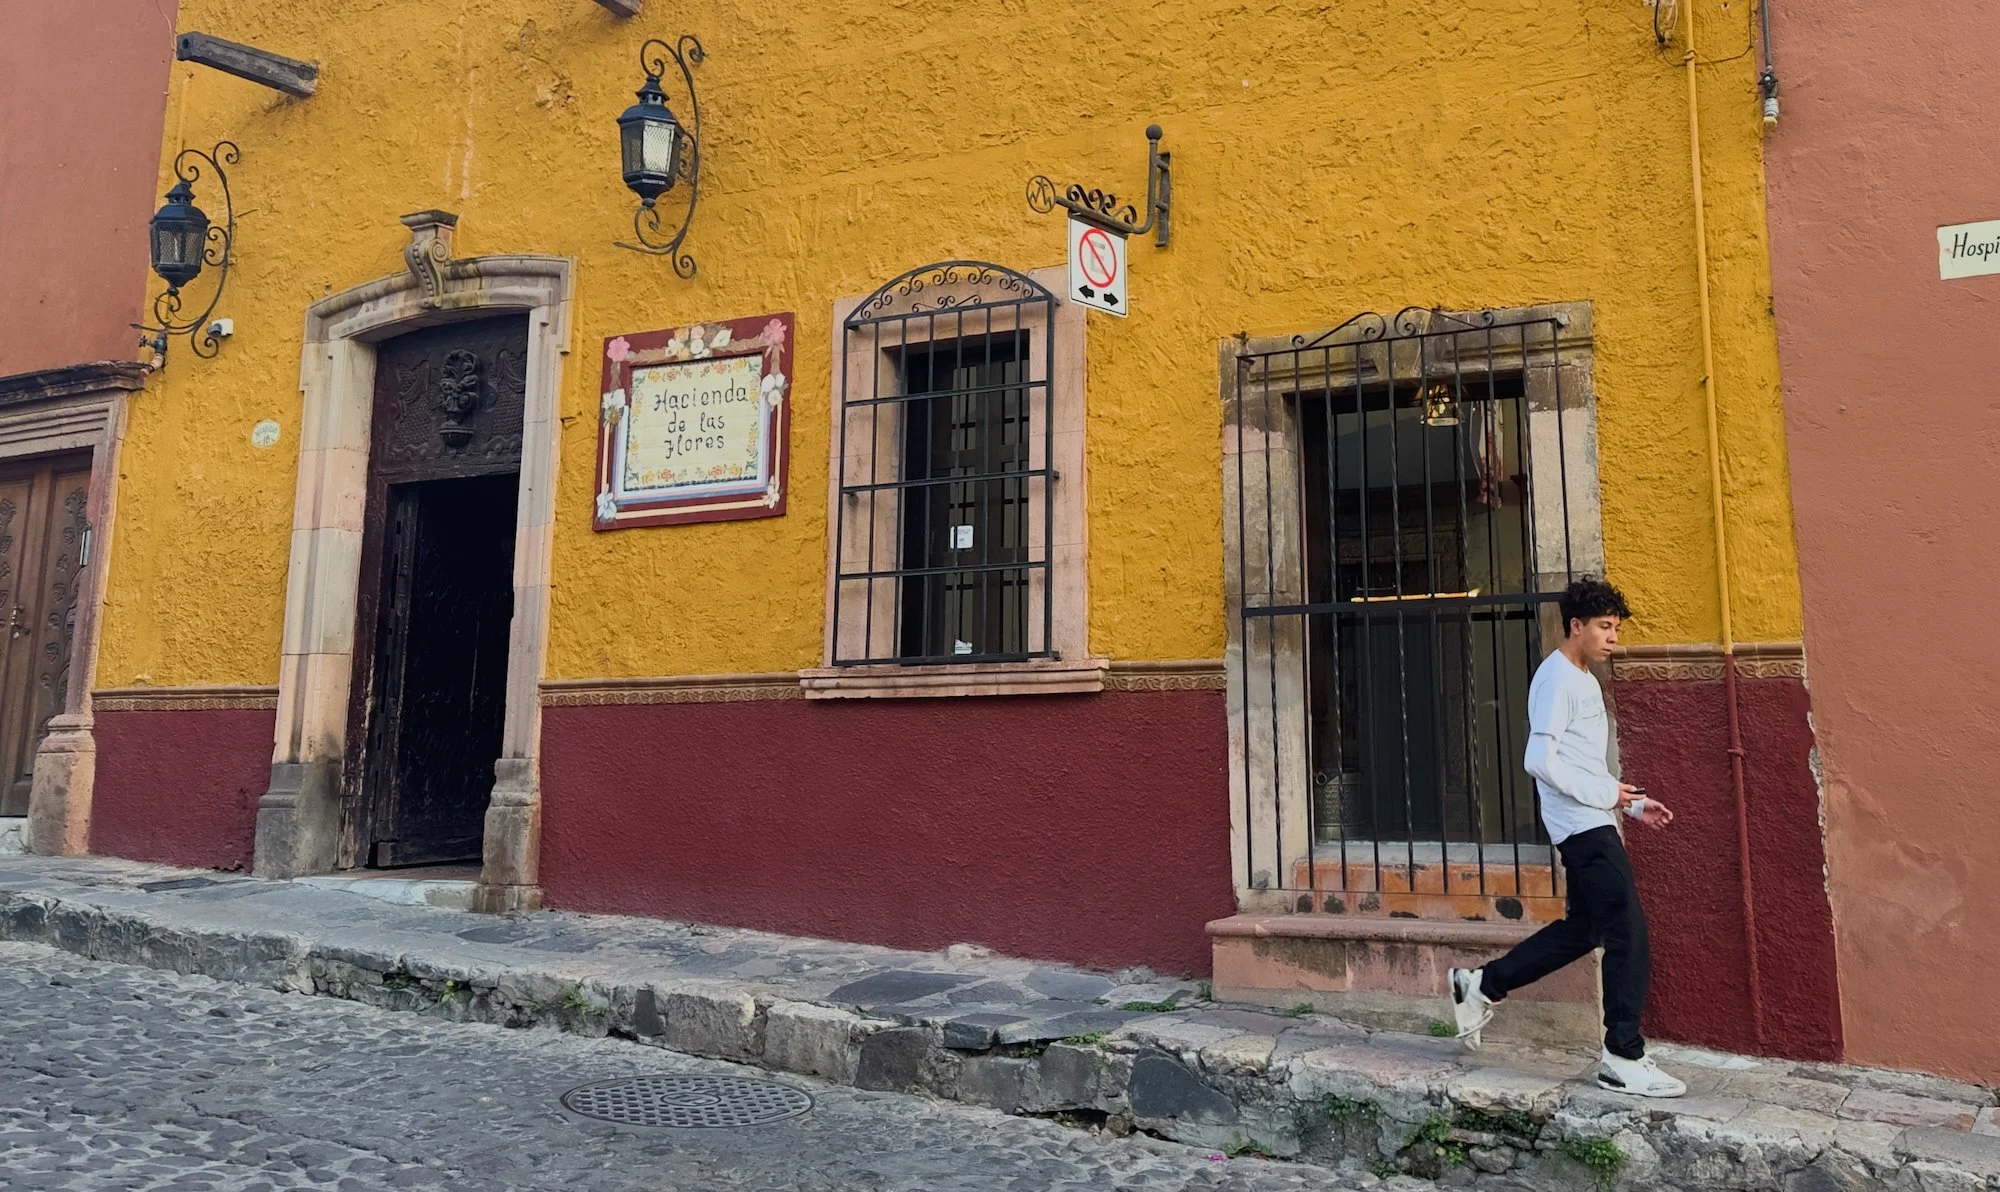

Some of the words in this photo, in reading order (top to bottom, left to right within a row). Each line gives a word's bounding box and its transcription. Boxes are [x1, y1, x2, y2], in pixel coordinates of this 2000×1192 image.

[1952, 232, 2000, 262] Hospi
[653, 378, 748, 413] Hacienda
[668, 411, 686, 433] de
[700, 412, 725, 432] las
[664, 434, 724, 459] Flores
